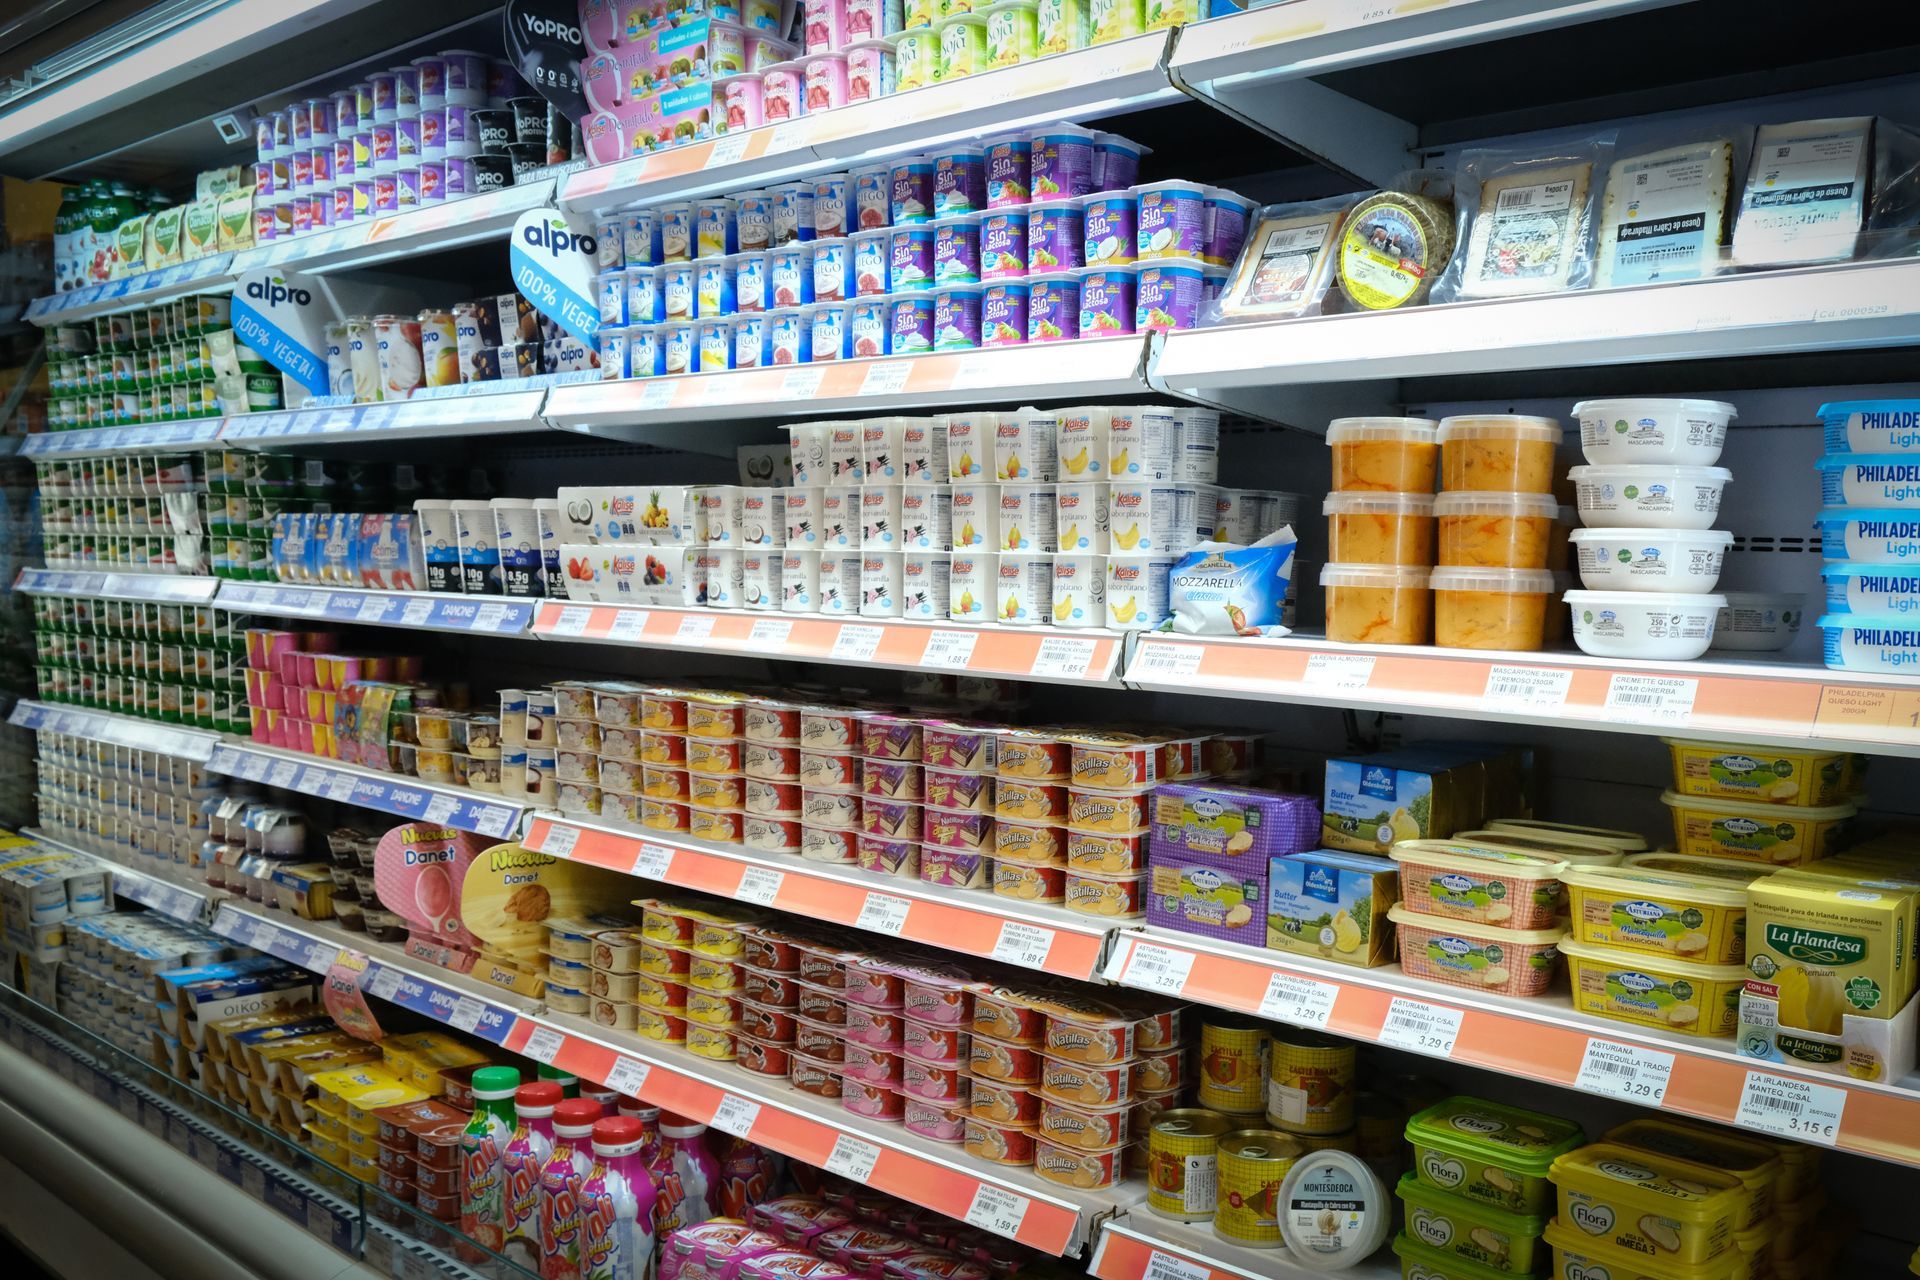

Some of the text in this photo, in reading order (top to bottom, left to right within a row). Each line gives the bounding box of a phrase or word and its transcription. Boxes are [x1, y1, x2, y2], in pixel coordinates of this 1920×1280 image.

[523, 12, 582, 45] YoPRO
[992, 158, 1011, 172] Sin
[938, 170, 952, 182] Sin
[895, 181, 909, 193] Sin
[1755, 185, 1850, 206] Queso de Cabra Madurado
[1142, 207, 1161, 223] Sin
[1088, 218, 1106, 232] Sin
[1620, 217, 1701, 238] Queso de Cabra Madurado
[523, 221, 598, 259] alpro
[988, 229, 1007, 243] Sin
[894, 246, 910, 259] Sin
[246, 277, 311, 308] alpro
[515, 265, 557, 307] 100%
[1140, 283, 1159, 298] Sin
[1086, 289, 1104, 303] Sin
[987, 300, 1005, 313] Sin
[897, 314, 914, 327] Sin
[234, 313, 315, 382] 100% VEGETAL
[560, 345, 584, 368] alpro
[1064, 416, 1090, 433] Kalise
[1861, 412, 1920, 430] PHILADE
[950, 422, 971, 438] Kalise
[998, 423, 1020, 438] Kalise
[1889, 432, 1920, 448] Ligh
[610, 495, 635, 516] Kalise
[1117, 493, 1142, 508] Kalise
[1886, 541, 1920, 558] Ligh
[429, 566, 445, 578] 10g
[611, 555, 635, 575] Kalise
[467, 568, 483, 581] 10g
[1115, 566, 1140, 581] Kalise
[1172, 576, 1242, 589] MOZZARELLA
[441, 603, 475, 618] DANONE
[1887, 596, 1920, 613] Ligh
[1880, 649, 1918, 666] Light
[1493, 667, 1565, 679] MASCARPONE SUAVE
[1497, 676, 1531, 685] CREMOSO
[1613, 684, 1676, 695] UNTAR C/HIERBA
[1615, 676, 1685, 687] CREMETTE QUESO
[1828, 688, 1885, 698] PHILADELPHIA
[1828, 697, 1883, 707] QUESO LIGHT
[1072, 757, 1111, 776] Natillas
[1330, 788, 1354, 801] Butter
[1074, 803, 1115, 822] Natillas
[401, 826, 457, 846] Nuevas
[998, 833, 1032, 848] Natillas
[405, 846, 456, 867] Danet
[1069, 844, 1106, 860] Natillas
[504, 870, 539, 886] Danet
[1066, 886, 1103, 903] Natillas
[1274, 889, 1298, 902] Butter
[1627, 906, 1662, 917] ASTURIANA
[1753, 901, 1790, 914] Mantequilla
[1791, 908, 1806, 916] pura
[1816, 911, 1839, 920] Irlanda
[1620, 924, 1667, 939] Mantequilla
[1622, 935, 1665, 947] TRADICIONAL
[1770, 927, 1862, 954] La Irlandesa
[490, 967, 516, 986] Danet
[1796, 966, 1837, 977] Premium
[330, 975, 356, 995] Danet
[1155, 975, 1175, 987] 3,29
[1273, 973, 1317, 988] OLDENBURGER
[1747, 982, 1774, 994] CON SAL
[1270, 980, 1329, 999] MANTEQUILLA C/SAL
[1851, 990, 1874, 998] TASTE
[224, 1000, 269, 1017] OIKOS
[906, 994, 938, 1007] Natillas
[1393, 999, 1430, 1012] ASTURIANA
[1615, 993, 1659, 1010] Mantequilla
[1293, 1006, 1325, 1022] 3,29 €
[1390, 1006, 1456, 1027] MANTEQUILLA C/SAL
[1616, 1005, 1657, 1018] TRADICIONAL
[800, 1034, 833, 1049] Natillas
[1051, 1034, 1091, 1048] Natillas
[1417, 1034, 1452, 1052] 3,29 €
[1590, 1041, 1634, 1056] ASTURIANA
[1780, 1035, 1840, 1056] La Irlandesa
[1588, 1049, 1671, 1073] MANTEQUILLA TRADIC
[793, 1071, 825, 1083] Natillas
[1046, 1073, 1085, 1087] Natillas
[1751, 1074, 1811, 1093] LA IRLANDESA
[1622, 1081, 1663, 1099] 3,29 €
[1748, 1083, 1812, 1104] MANTEQ. C/SAL
[906, 1111, 940, 1126] Natillas
[1045, 1117, 1086, 1132] Natillas
[1458, 1117, 1494, 1132] Flora
[1788, 1117, 1834, 1138] 3,15 €
[1039, 1158, 1079, 1171] Natillas
[1430, 1162, 1459, 1181] Flora
[1604, 1163, 1644, 1179] Flora
[469, 1175, 495, 1194] glub
[1303, 1183, 1354, 1193] MONTESDEOCA
[1468, 1185, 1502, 1200] OMEGA 3
[1637, 1182, 1678, 1196] OMEGA
[1577, 1207, 1607, 1227] Flora
[553, 1216, 581, 1237] glub
[994, 1217, 1019, 1234] 1,59 €
[1419, 1220, 1446, 1240] Flora
[589, 1238, 613, 1257] glub
[1455, 1244, 1488, 1262] OMEGA 3
[1616, 1236, 1656, 1256] OMEGA 3
[1153, 1252, 1179, 1266] CASTILLO
[1151, 1259, 1188, 1277] MANTEQUILLA
